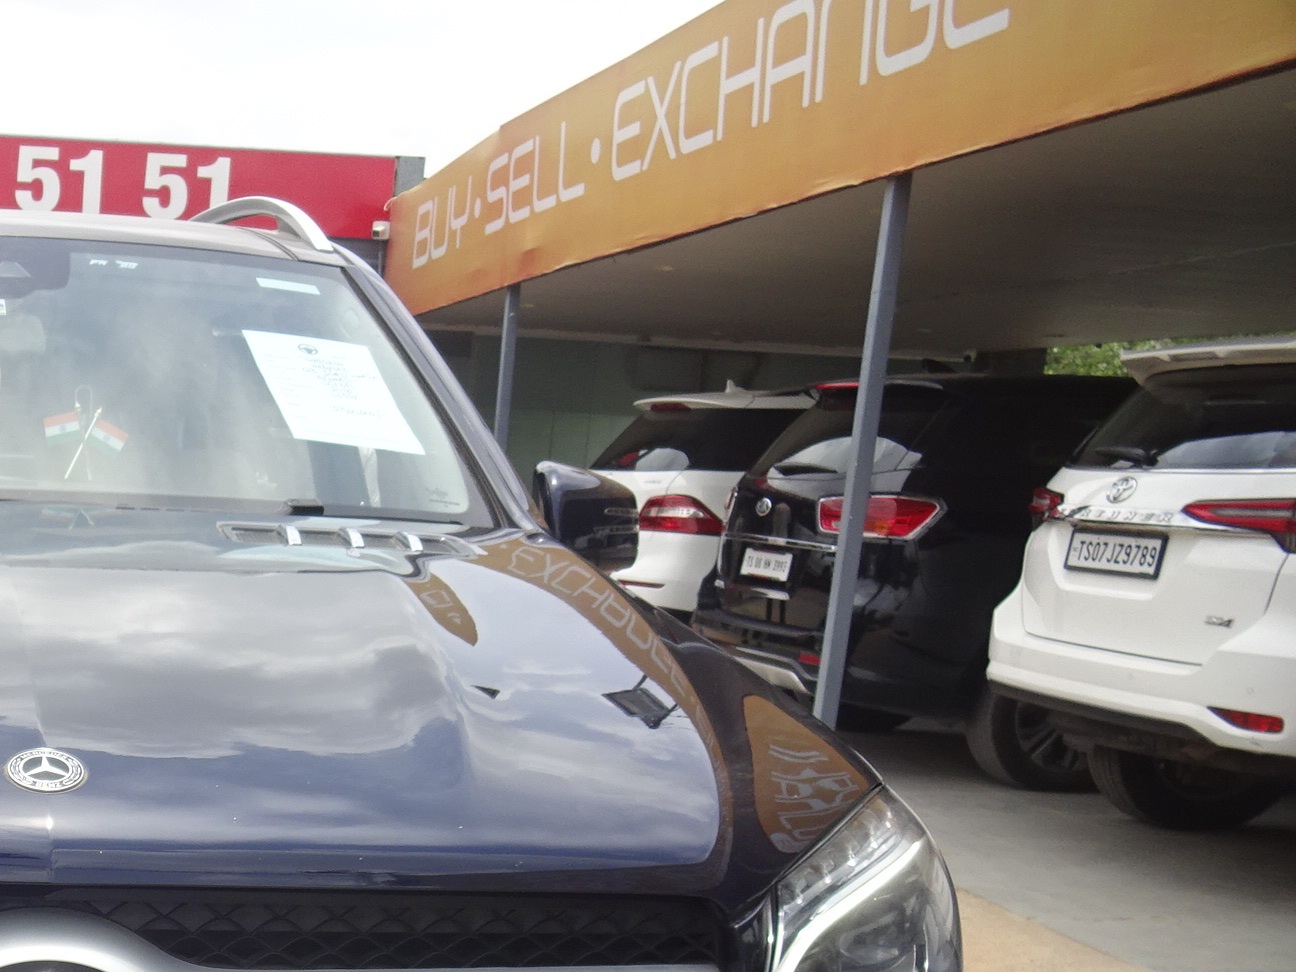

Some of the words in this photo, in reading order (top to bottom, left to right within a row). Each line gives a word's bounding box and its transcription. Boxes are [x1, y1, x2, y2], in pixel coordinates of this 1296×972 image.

[14, 145, 103, 214] 51
[142, 152, 231, 220] 51
[412, 175, 472, 270] BUY
[485, 121, 586, 235] SELL
[1077, 540, 1158, 568] TS07JZ9789
